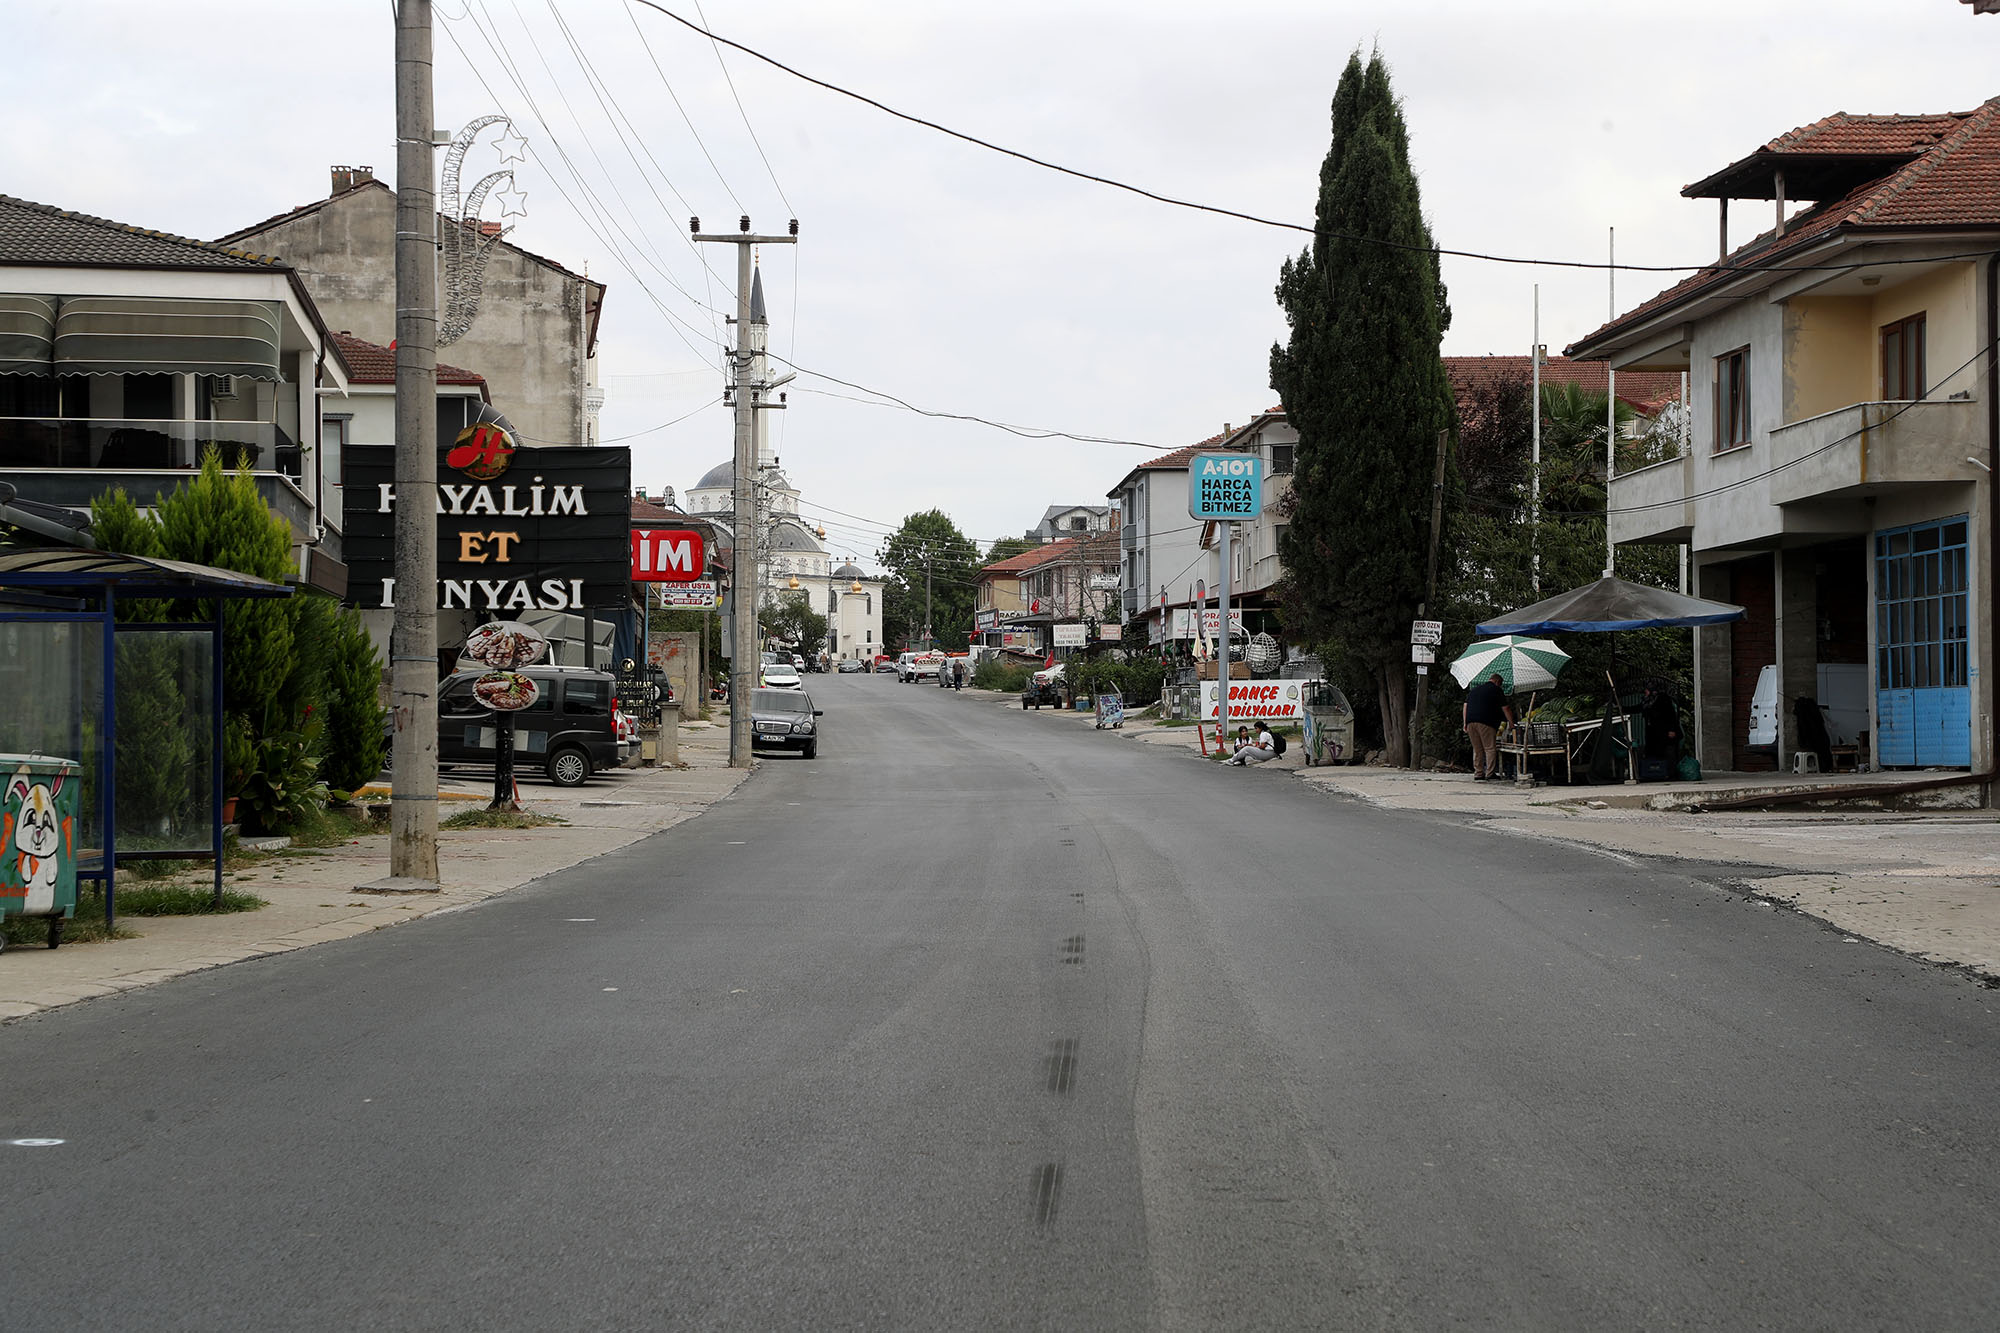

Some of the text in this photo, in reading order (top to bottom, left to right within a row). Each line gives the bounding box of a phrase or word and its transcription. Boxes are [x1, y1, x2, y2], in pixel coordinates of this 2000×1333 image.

[1201, 479, 1253, 490] HARCA
[1201, 490, 1252, 501] HARCA
[458, 531, 521, 564] ET
[691, 582, 711, 590] USTA
[1228, 686, 1280, 704] BAHÇE
